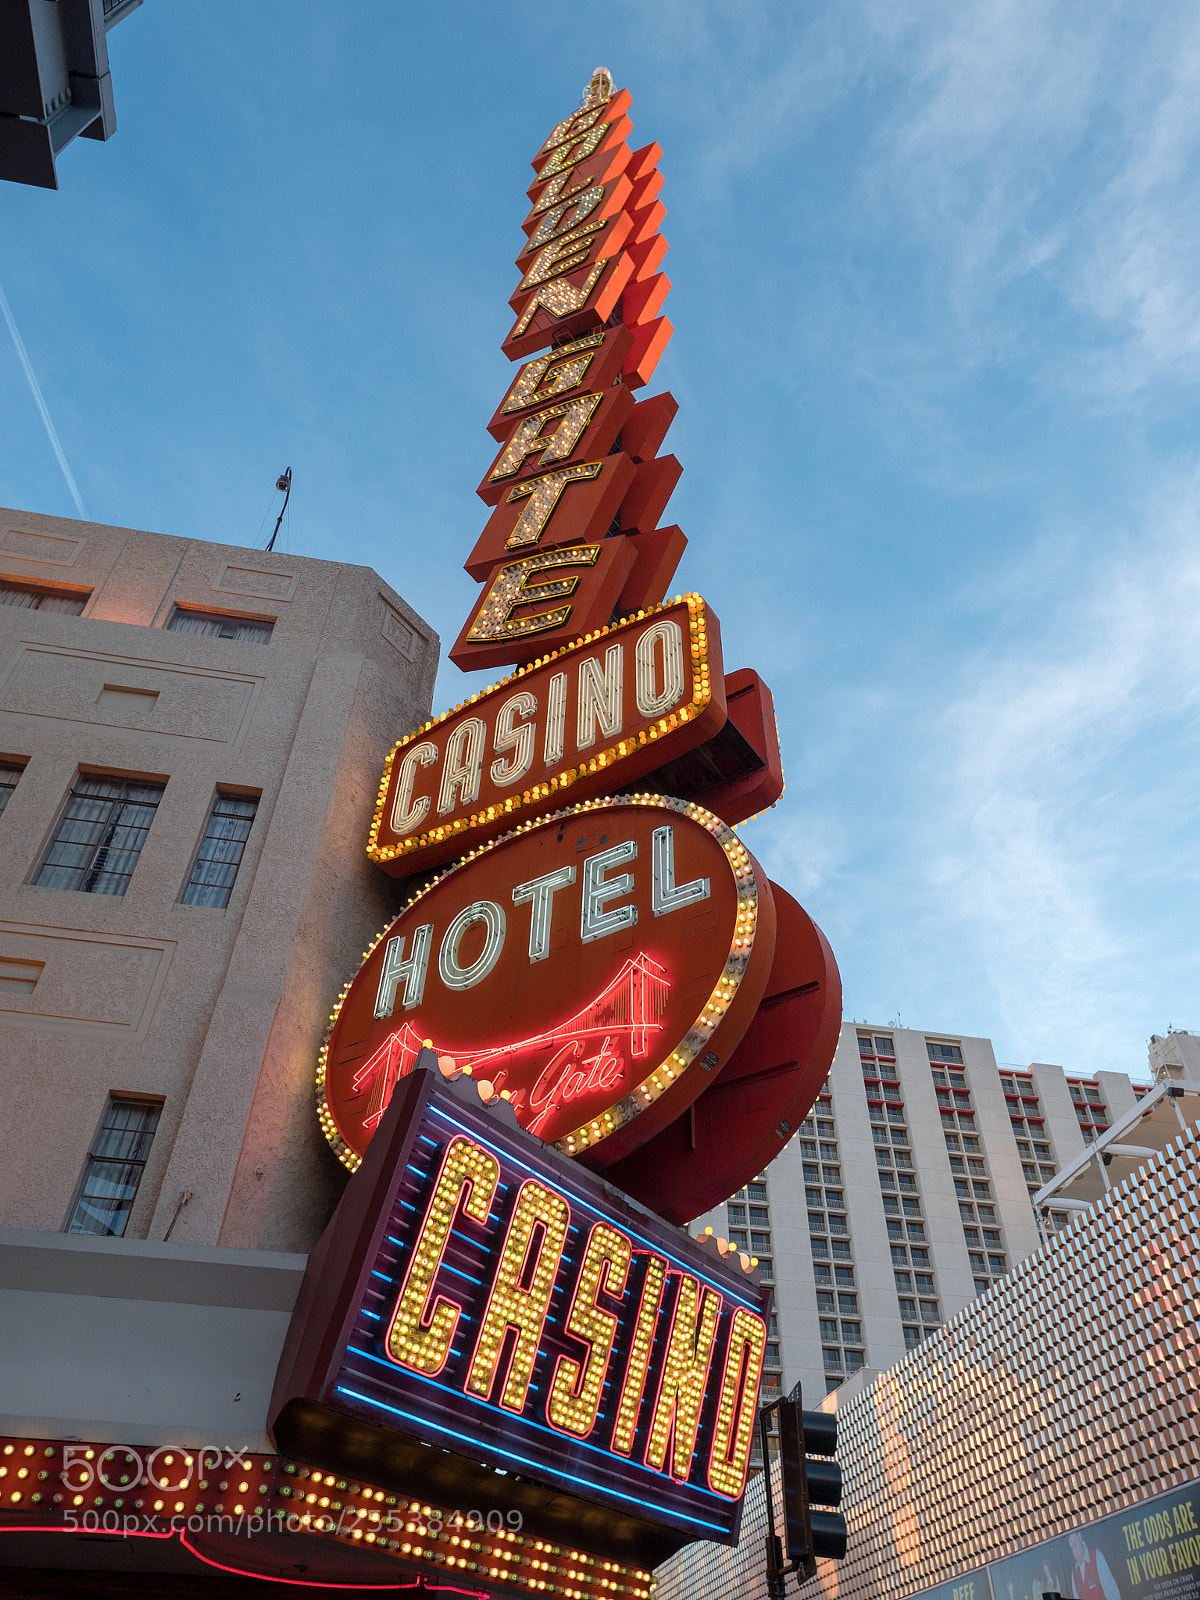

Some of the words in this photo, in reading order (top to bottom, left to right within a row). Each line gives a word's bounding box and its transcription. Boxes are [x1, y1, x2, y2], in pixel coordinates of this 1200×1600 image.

[511, 97, 612, 340] GOLDEN
[466, 332, 605, 645] GATE
[389, 619, 686, 836] CASINO
[373, 824, 711, 1020] HOTEL
[526, 1035, 625, 1134] Gate
[384, 1133, 768, 1502] CASINO
[1122, 1521, 1145, 1552] THE
[1143, 1510, 1174, 1545] ODDS
[1172, 1501, 1198, 1535] ARE
[1126, 1556, 1142, 1585] IN
[1139, 1547, 1172, 1580] YOUR
